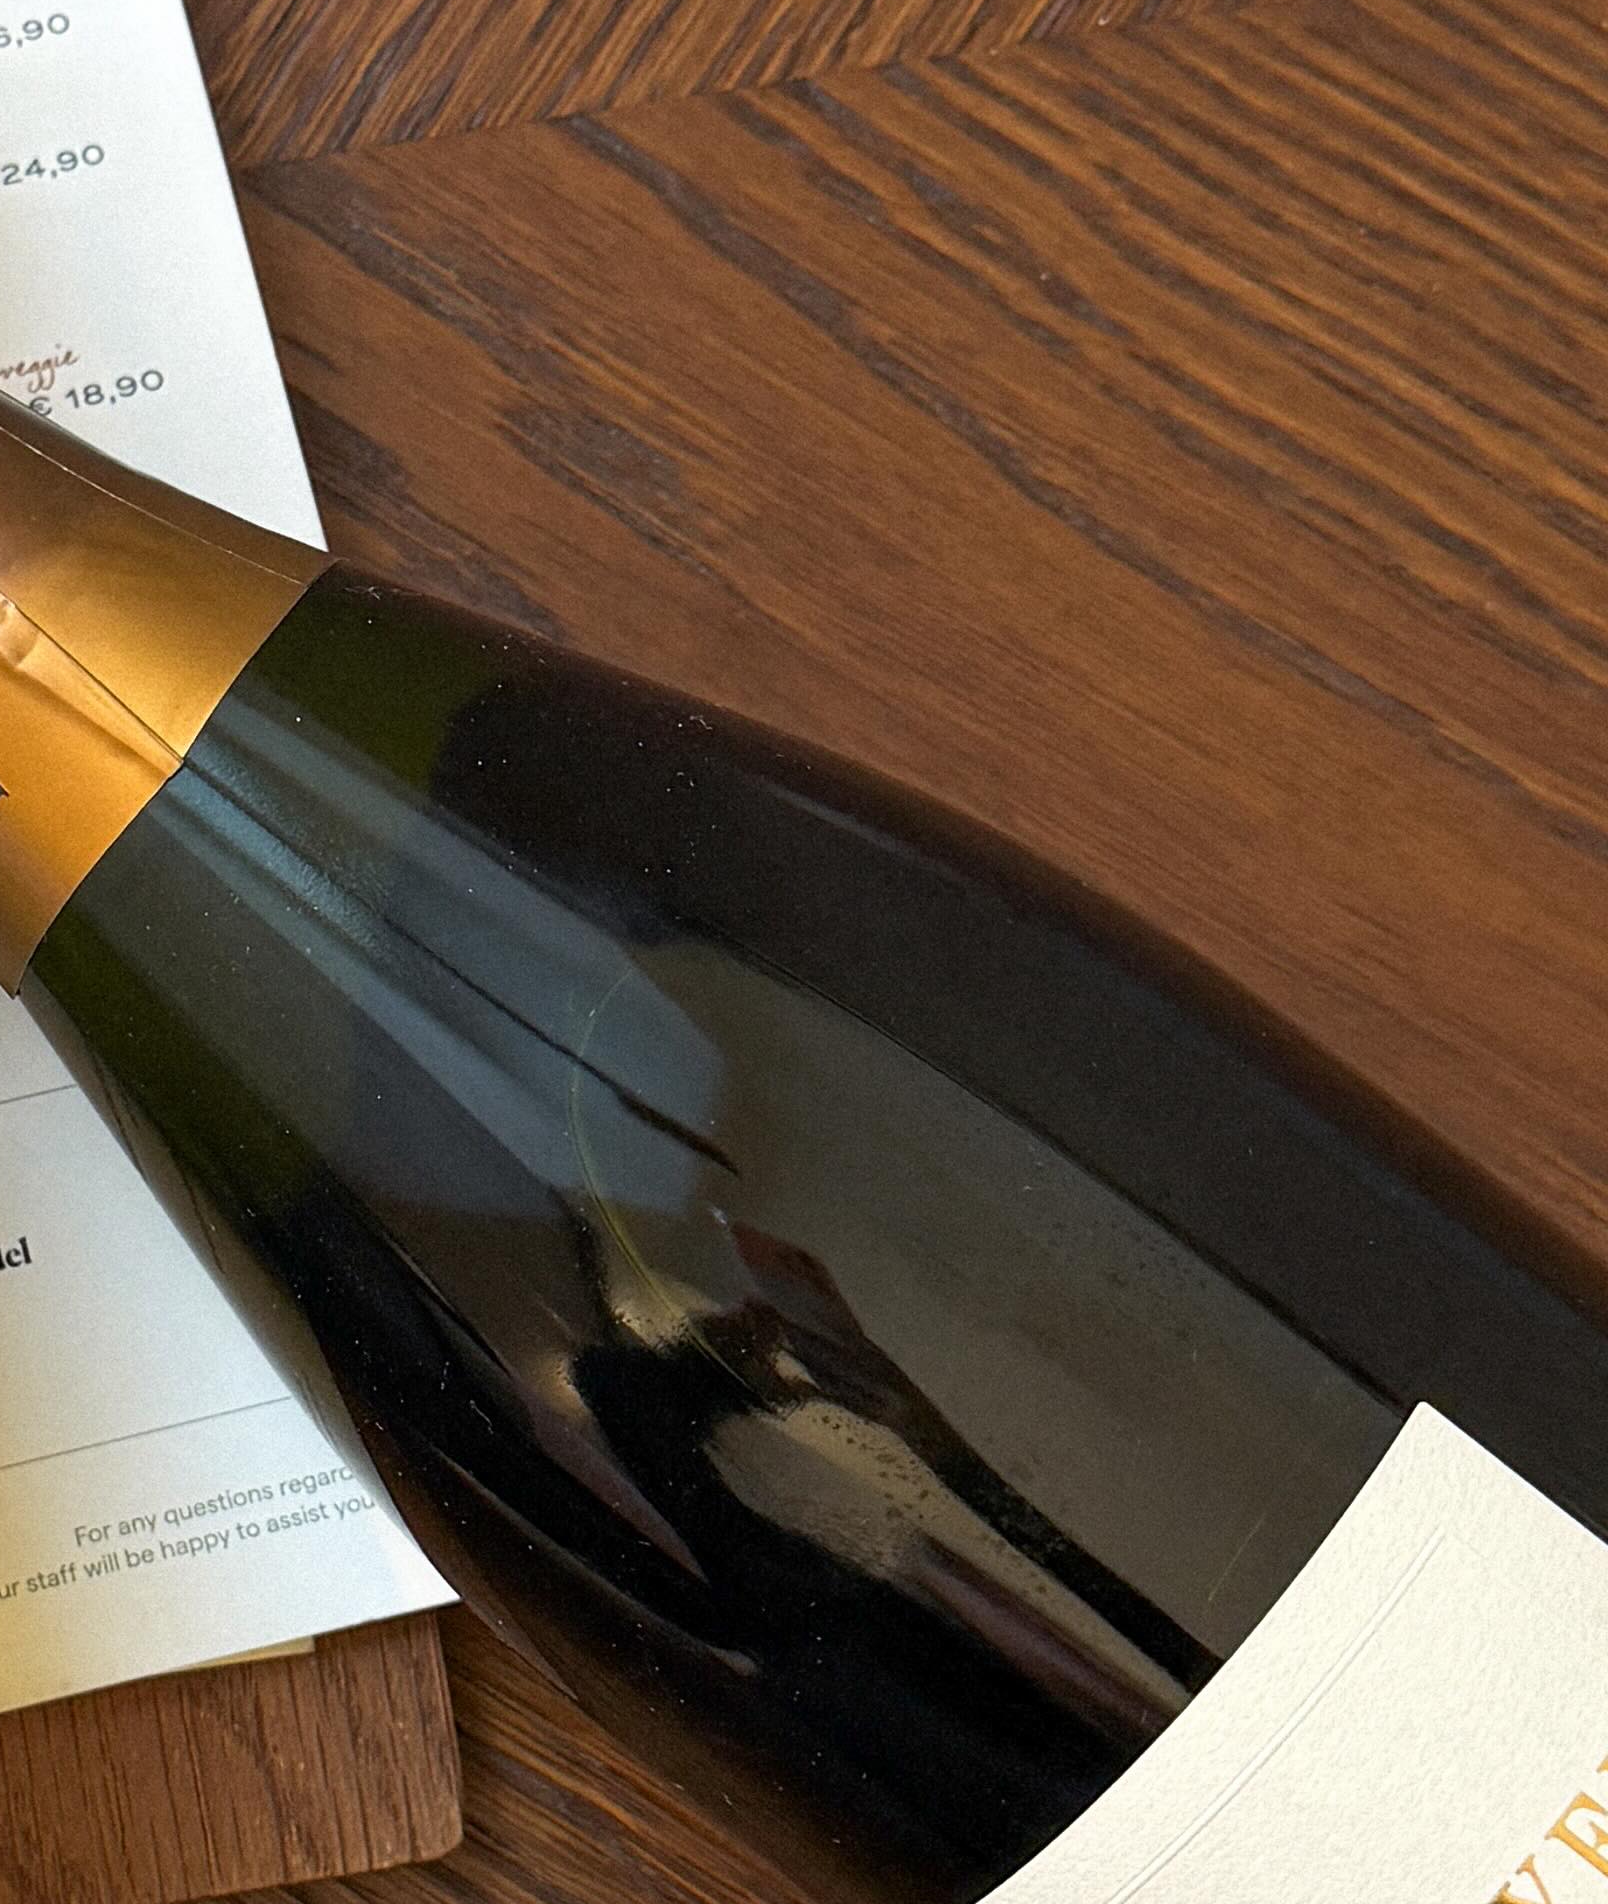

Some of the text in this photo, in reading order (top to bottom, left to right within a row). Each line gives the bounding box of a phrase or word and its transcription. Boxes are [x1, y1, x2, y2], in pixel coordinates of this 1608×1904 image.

[0, 144, 105, 186] 24,90
[64, 369, 164, 409] 18,90
[73, 1461, 354, 1548] For any questions regar
[25, 1562, 76, 1594] staff
[83, 1552, 120, 1579] will
[123, 1548, 154, 1569] be
[157, 1529, 229, 1561] happy
[235, 1522, 261, 1540] to
[266, 1502, 330, 1534] assist
